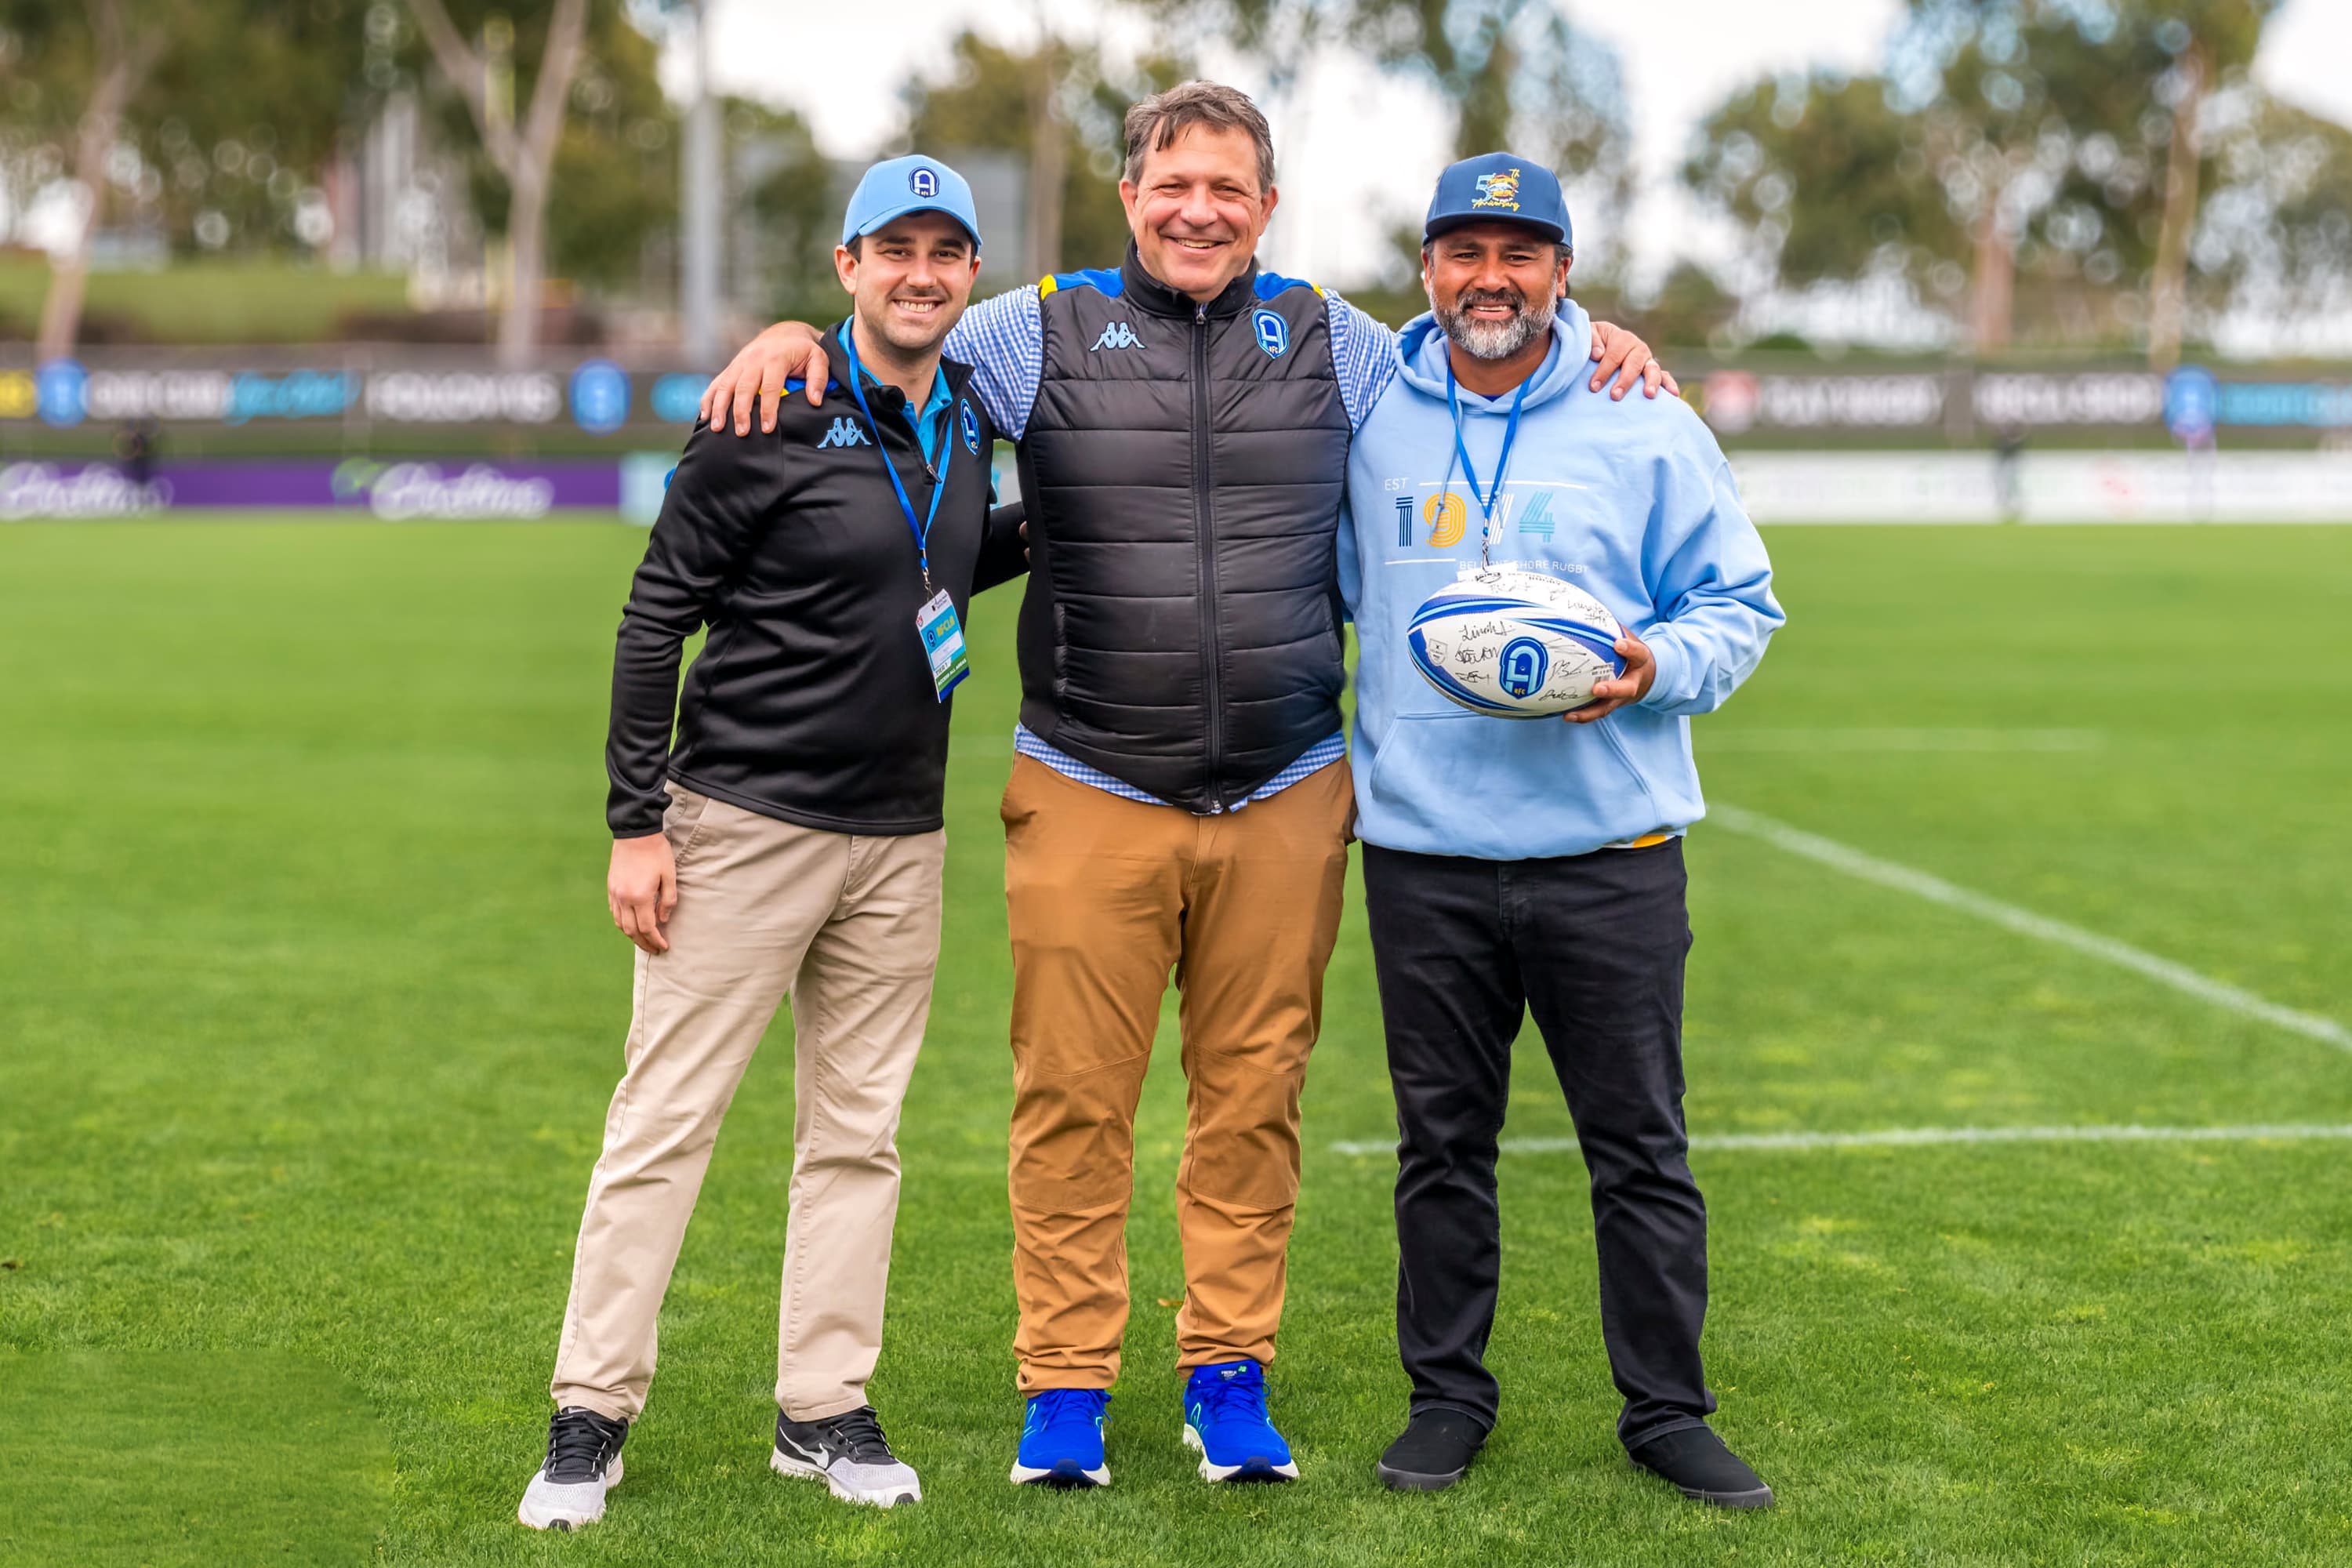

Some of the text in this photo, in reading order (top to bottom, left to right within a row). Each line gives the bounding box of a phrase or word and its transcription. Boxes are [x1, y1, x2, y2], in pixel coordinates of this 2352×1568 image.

[1385, 477, 1407, 491] EST
[1396, 492, 1555, 548] 1974
[1552, 561, 1588, 574] RUGBY
